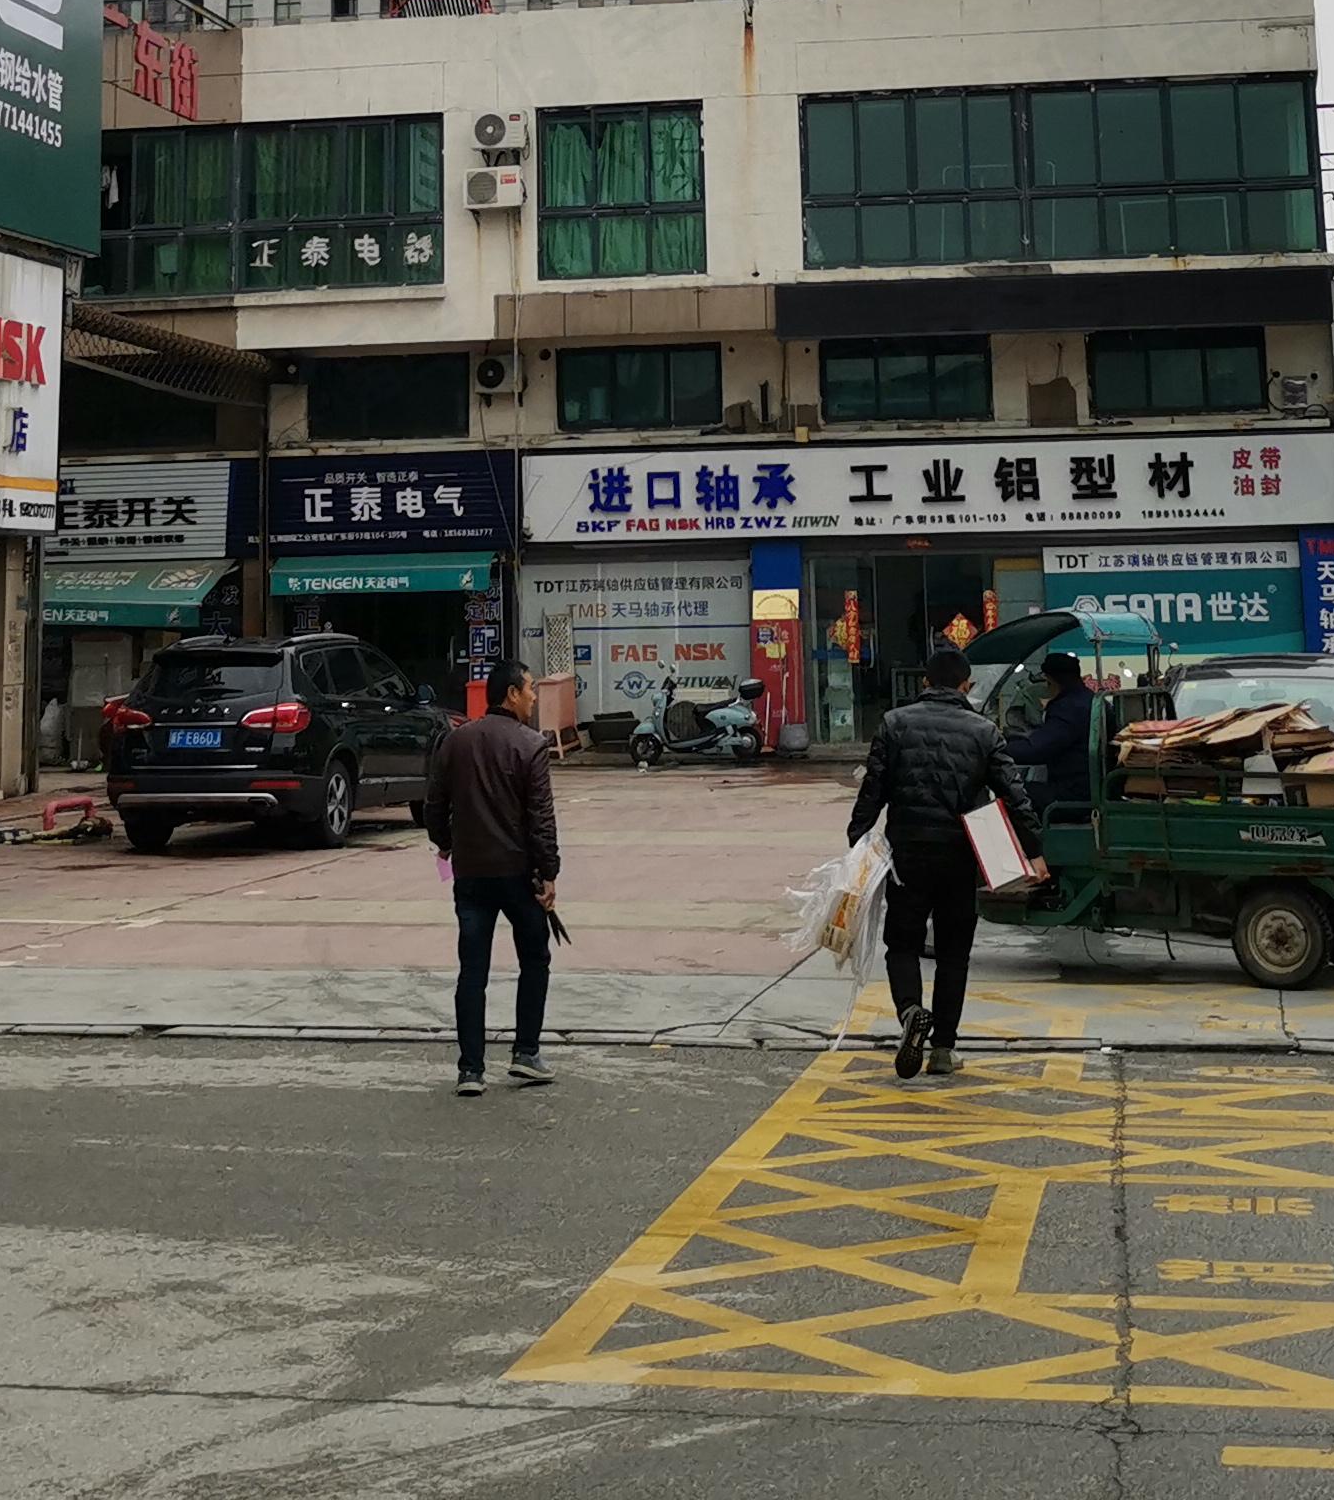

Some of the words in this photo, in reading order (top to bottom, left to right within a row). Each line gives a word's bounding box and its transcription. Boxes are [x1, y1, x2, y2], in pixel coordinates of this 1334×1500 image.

[250, 231, 435, 269] 正泰电器
[1232, 446, 1282, 471] 皮带
[587, 462, 797, 514] 进口轴承
[849, 451, 1195, 504] 工业铝型材
[1232, 474, 1282, 497] 油封
[304, 484, 464, 523] 正泰电气
[575, 519, 622, 534] SKF
[625, 518, 661, 532] FAG
[665, 517, 701, 531] NSK
[704, 516, 736, 531] HRB
[740, 515, 787, 529] ZWZ
[791, 514, 841, 529] HIWIN
[1055, 554, 1088, 569] TDT
[303, 575, 364, 590] TENGEN
[533, 580, 563, 594] TDT
[611, 600, 710, 618] 天马轴承代理
[1207, 590, 1271, 623] 世达
[610, 643, 658, 662] FAG
[674, 642, 727, 662] NSK
